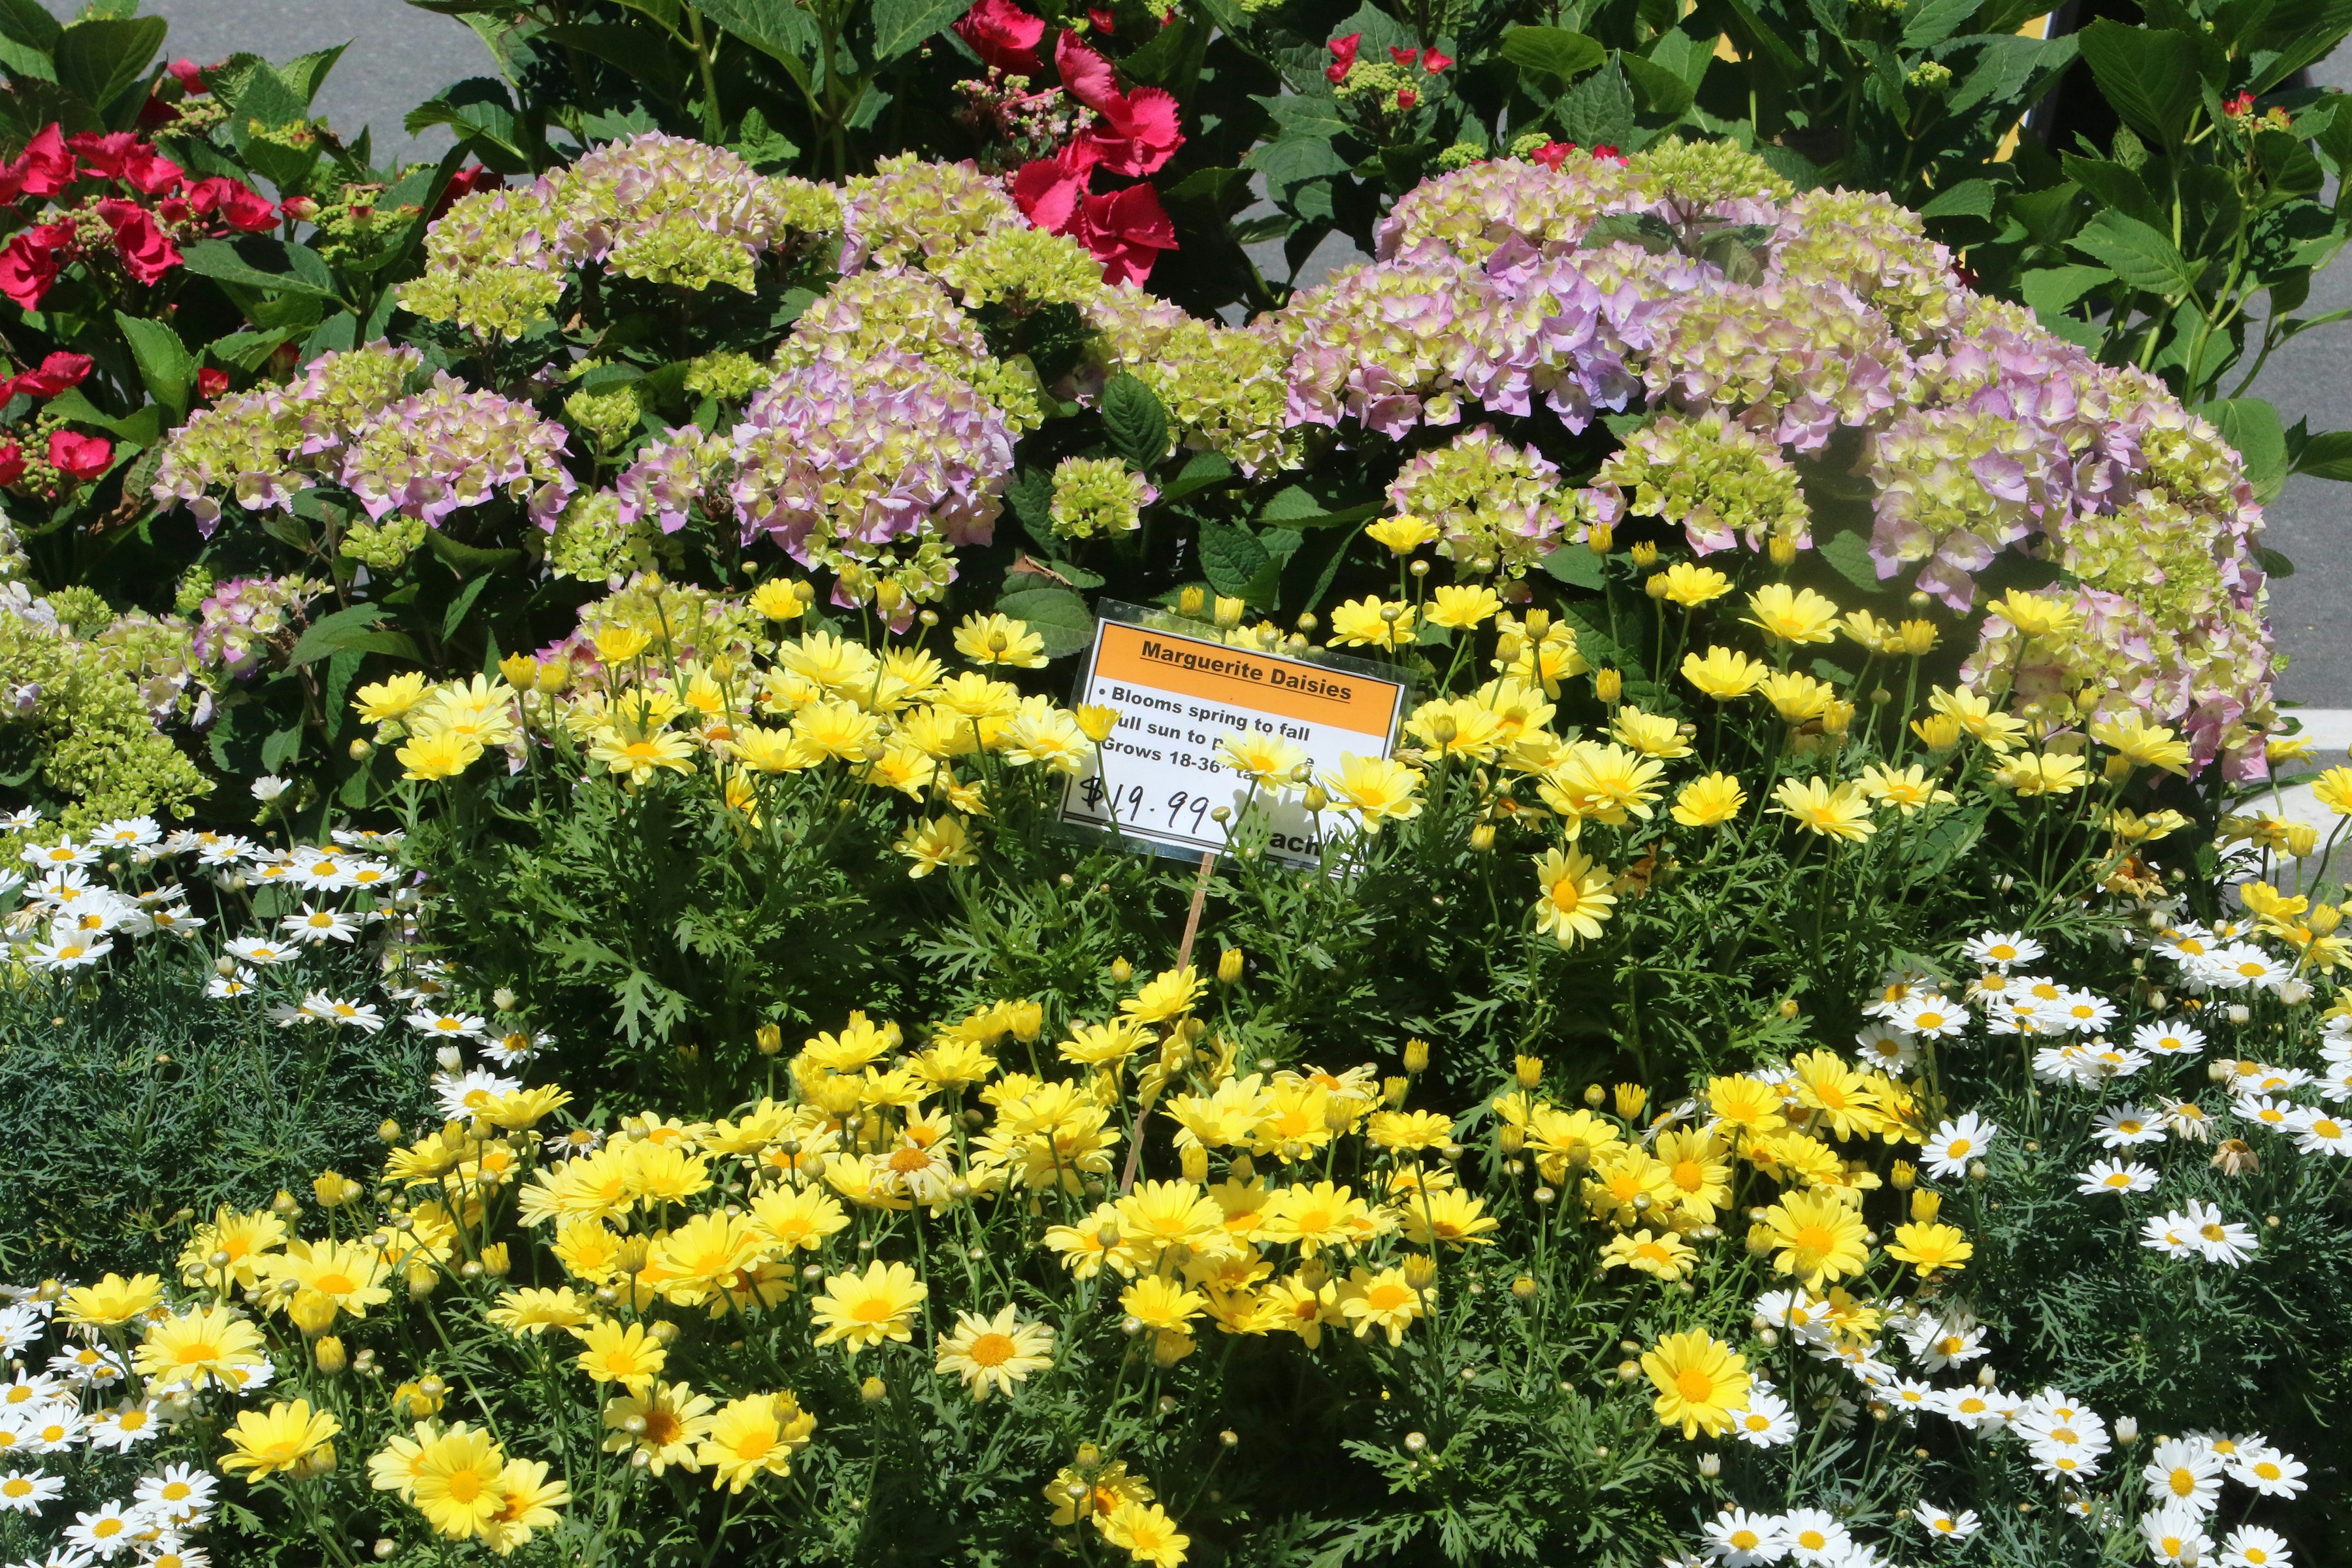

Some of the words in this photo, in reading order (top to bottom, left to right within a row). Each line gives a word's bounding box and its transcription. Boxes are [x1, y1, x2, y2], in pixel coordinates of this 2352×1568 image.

[1141, 641, 1264, 680] Marguerite
[1270, 668, 1352, 700] Daisies
[1111, 687, 1183, 714] Blooms
[1188, 706, 1248, 731] spring
[1254, 718, 1273, 733] to
[1279, 723, 1311, 741] fall
[1115, 712, 1142, 730] ull
[1147, 722, 1181, 740] sun
[1188, 729, 1206, 745] to
[1102, 737, 1162, 760] Grows
[1079, 775, 1209, 834] $19.99
